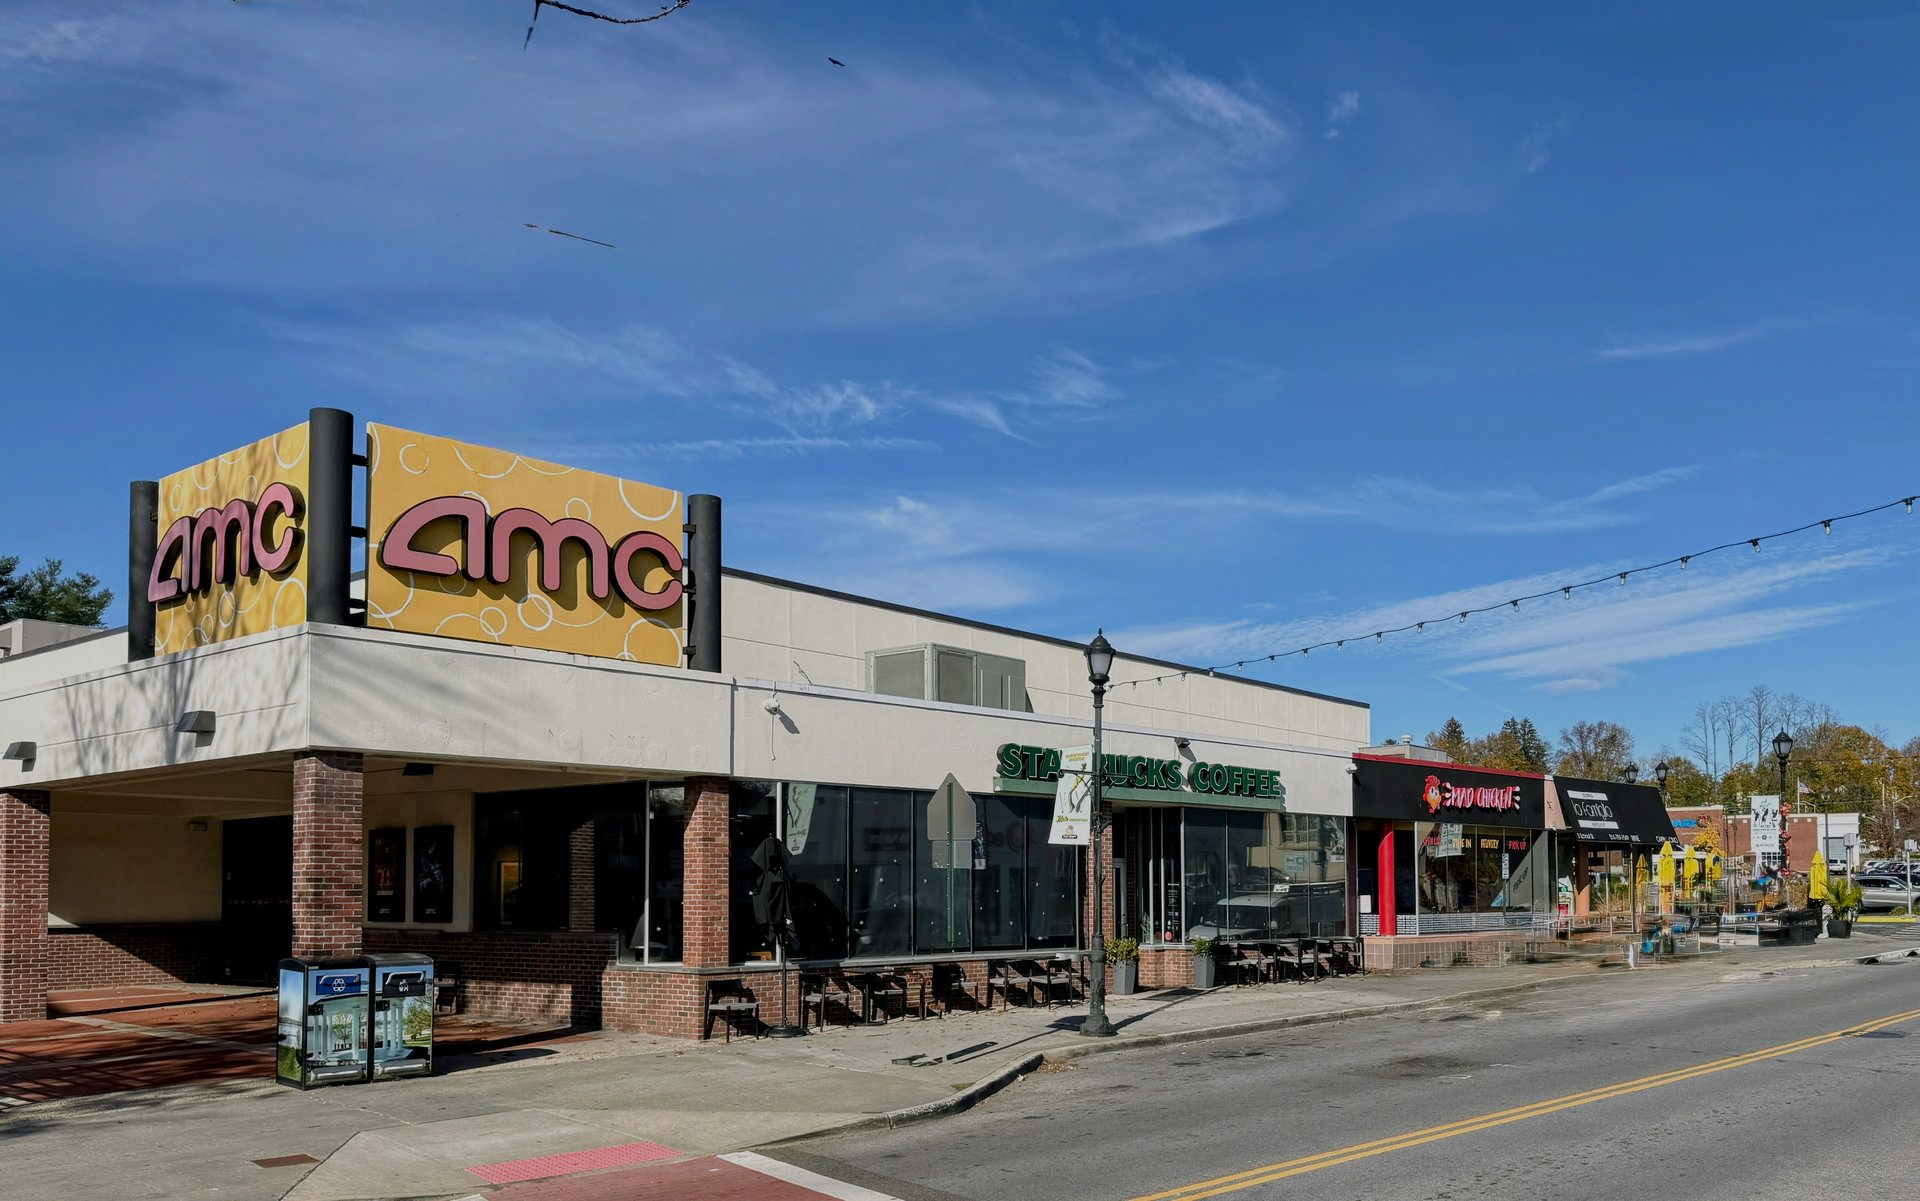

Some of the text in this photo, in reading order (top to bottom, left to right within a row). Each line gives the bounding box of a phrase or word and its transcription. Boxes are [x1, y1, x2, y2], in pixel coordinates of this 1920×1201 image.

[147, 481, 304, 603] amc
[379, 494, 685, 611] amc
[997, 742, 1282, 797] STABUCKS COFFEE
[1451, 786, 1513, 812] MAD CHICKEN
